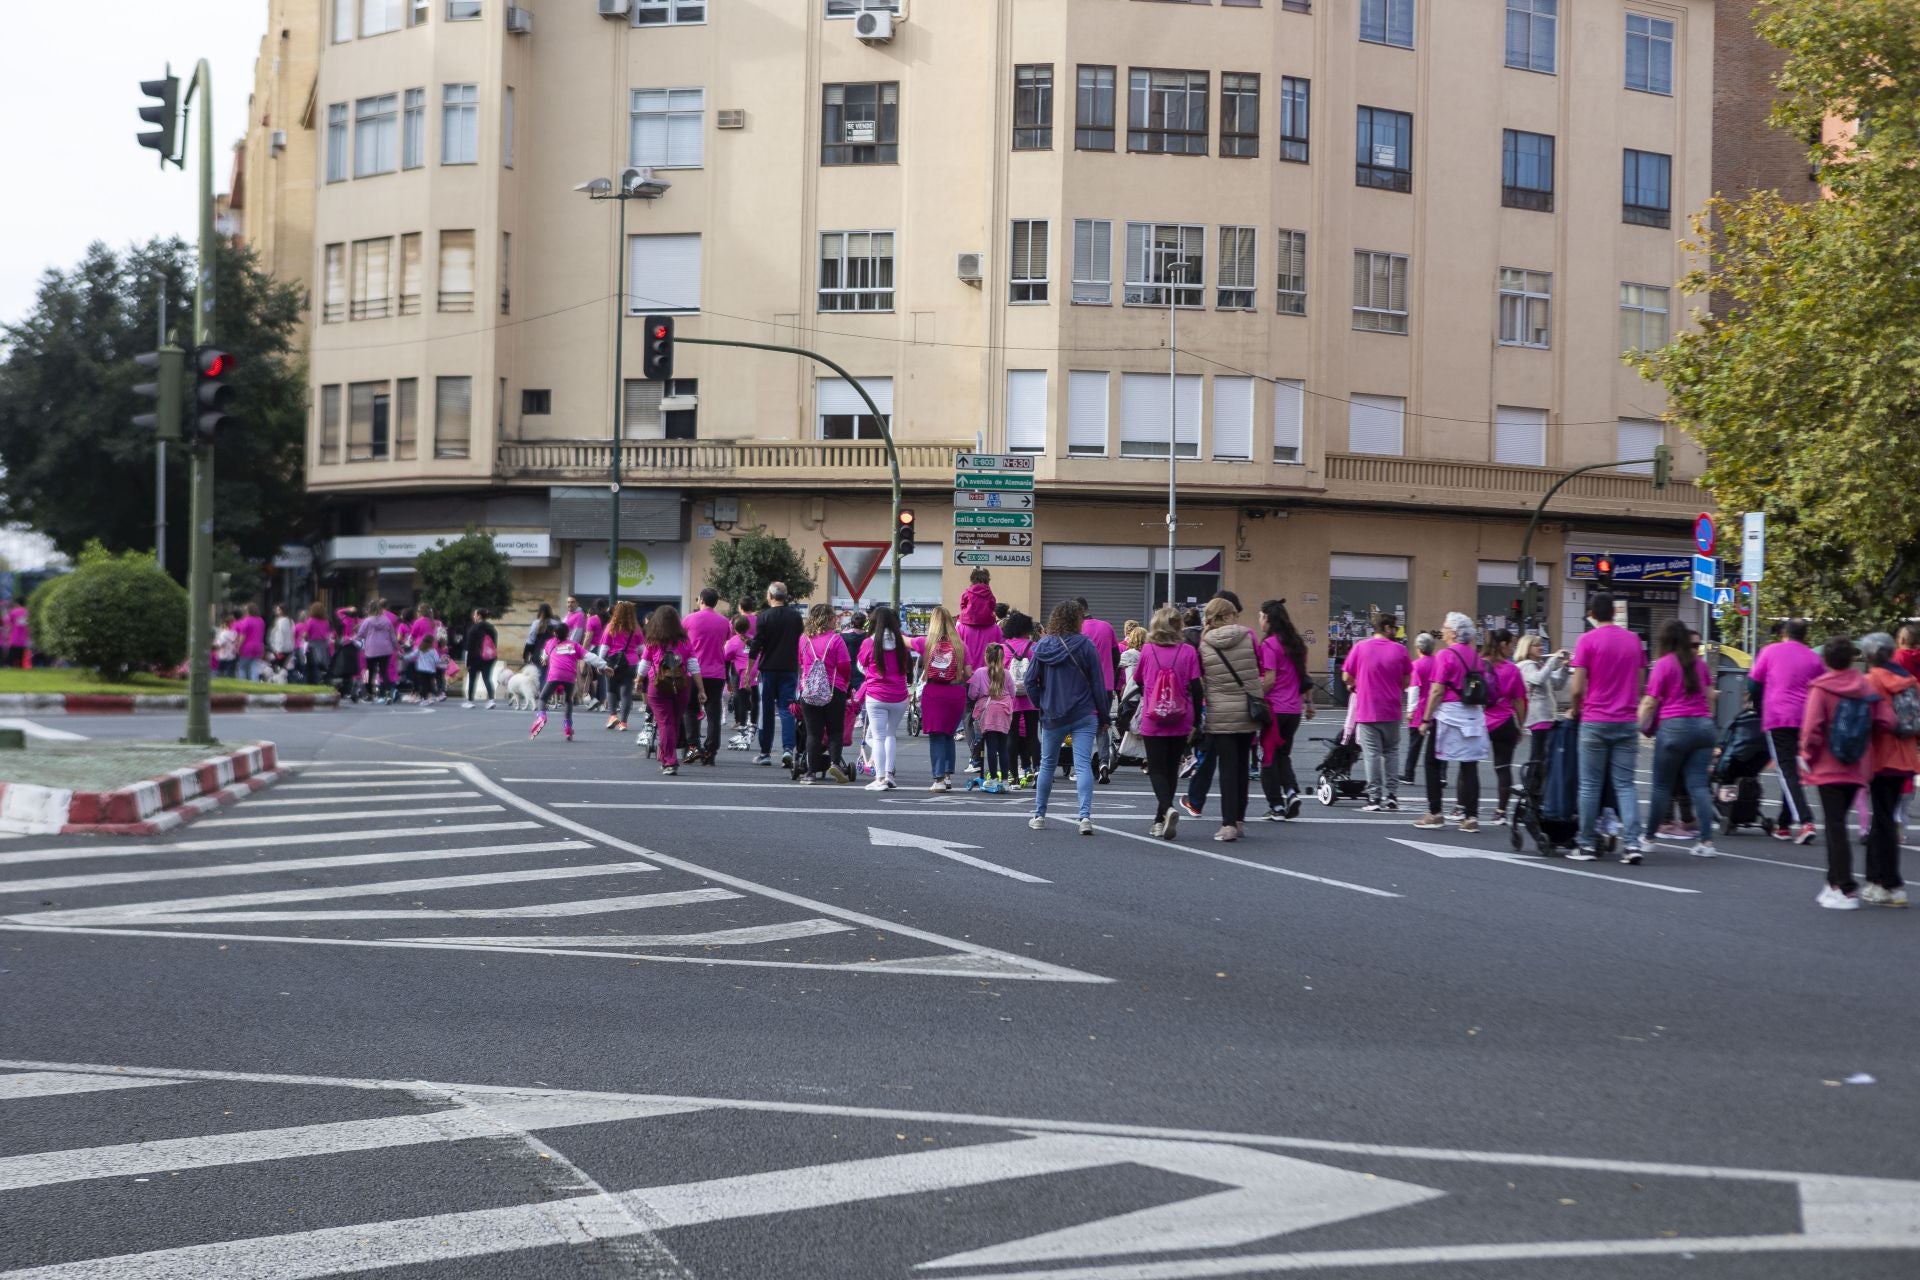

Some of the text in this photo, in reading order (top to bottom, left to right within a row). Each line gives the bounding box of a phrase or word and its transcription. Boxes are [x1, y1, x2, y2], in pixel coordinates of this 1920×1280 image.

[1003, 459, 1029, 468] N-630
[988, 516, 1015, 524] Cordero
[494, 541, 538, 550] atural Optics
